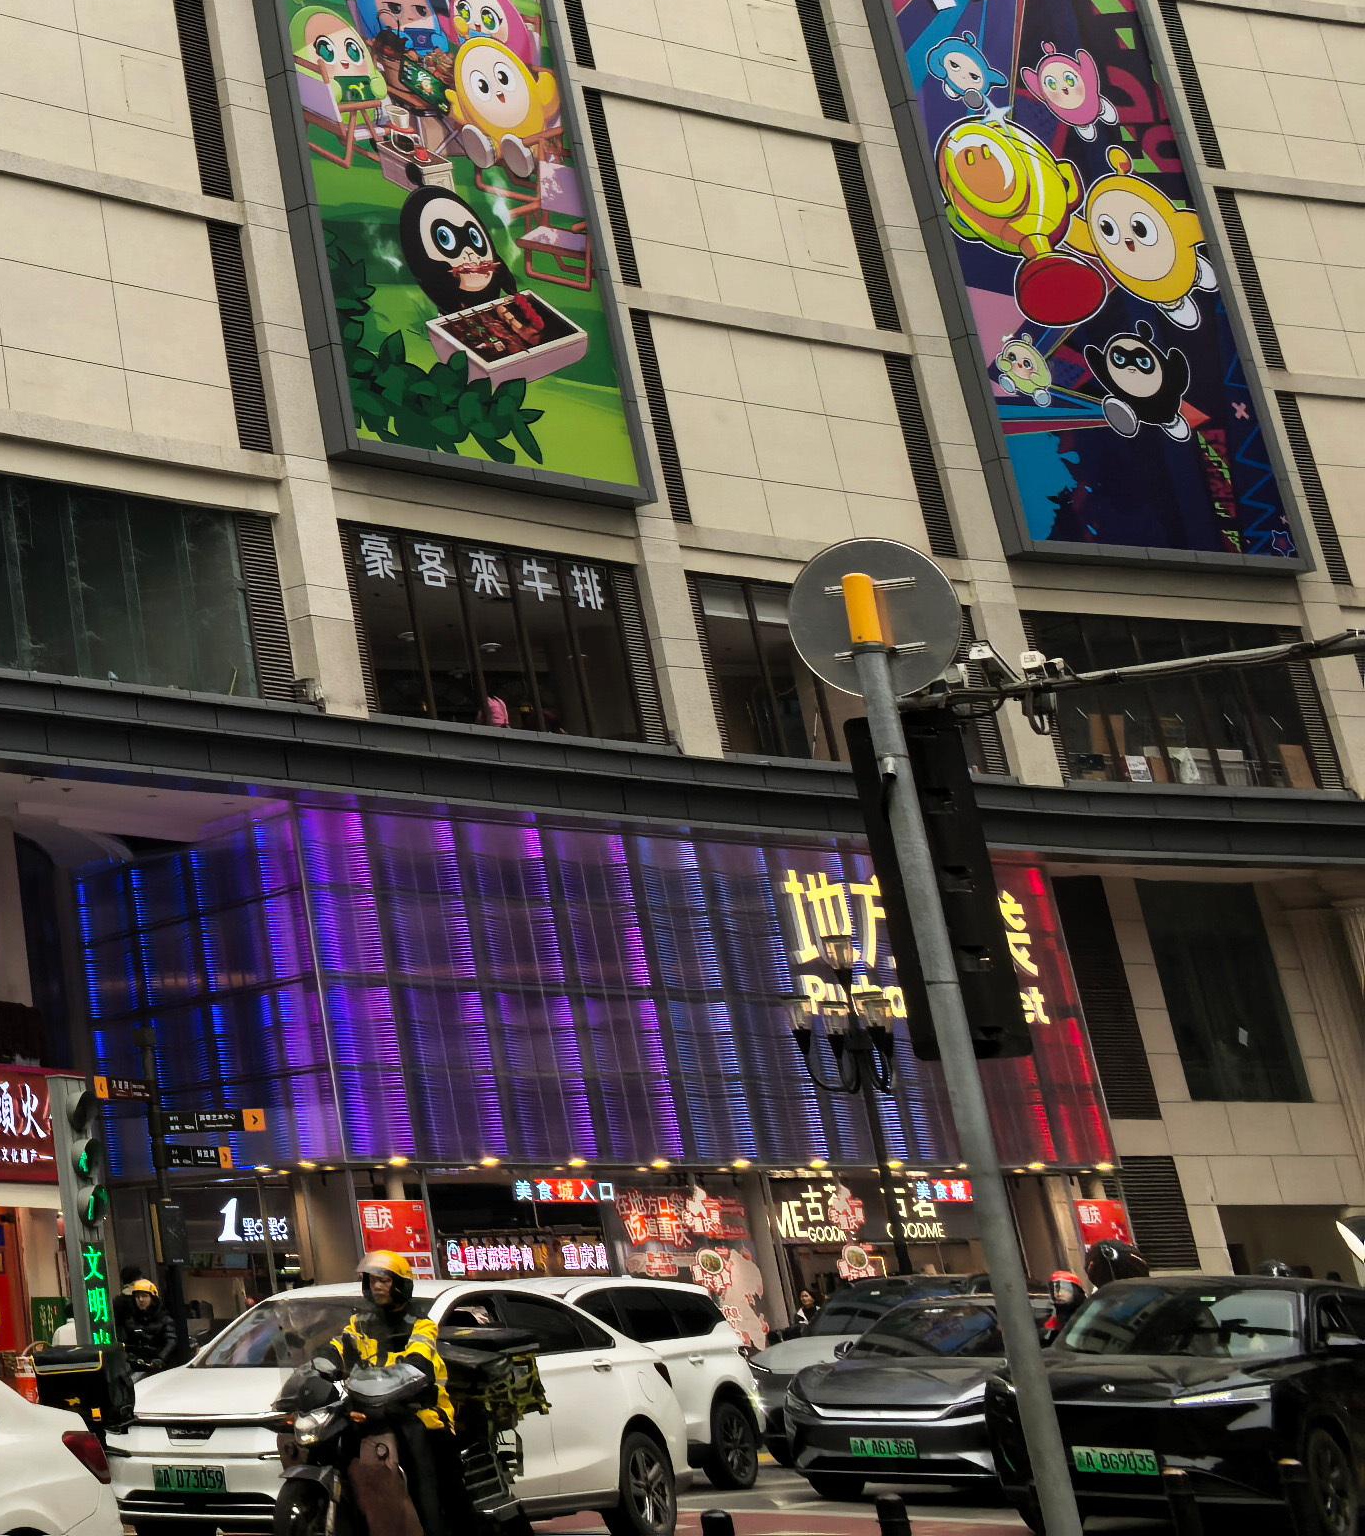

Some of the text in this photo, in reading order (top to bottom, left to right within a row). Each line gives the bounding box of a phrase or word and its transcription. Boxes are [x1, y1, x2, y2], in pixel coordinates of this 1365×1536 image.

[514, 1179, 616, 1202] 美食城入口
[916, 1180, 968, 1200] 美食城
[362, 1206, 394, 1230] 重庆
[1077, 1205, 1103, 1225] 重庆
